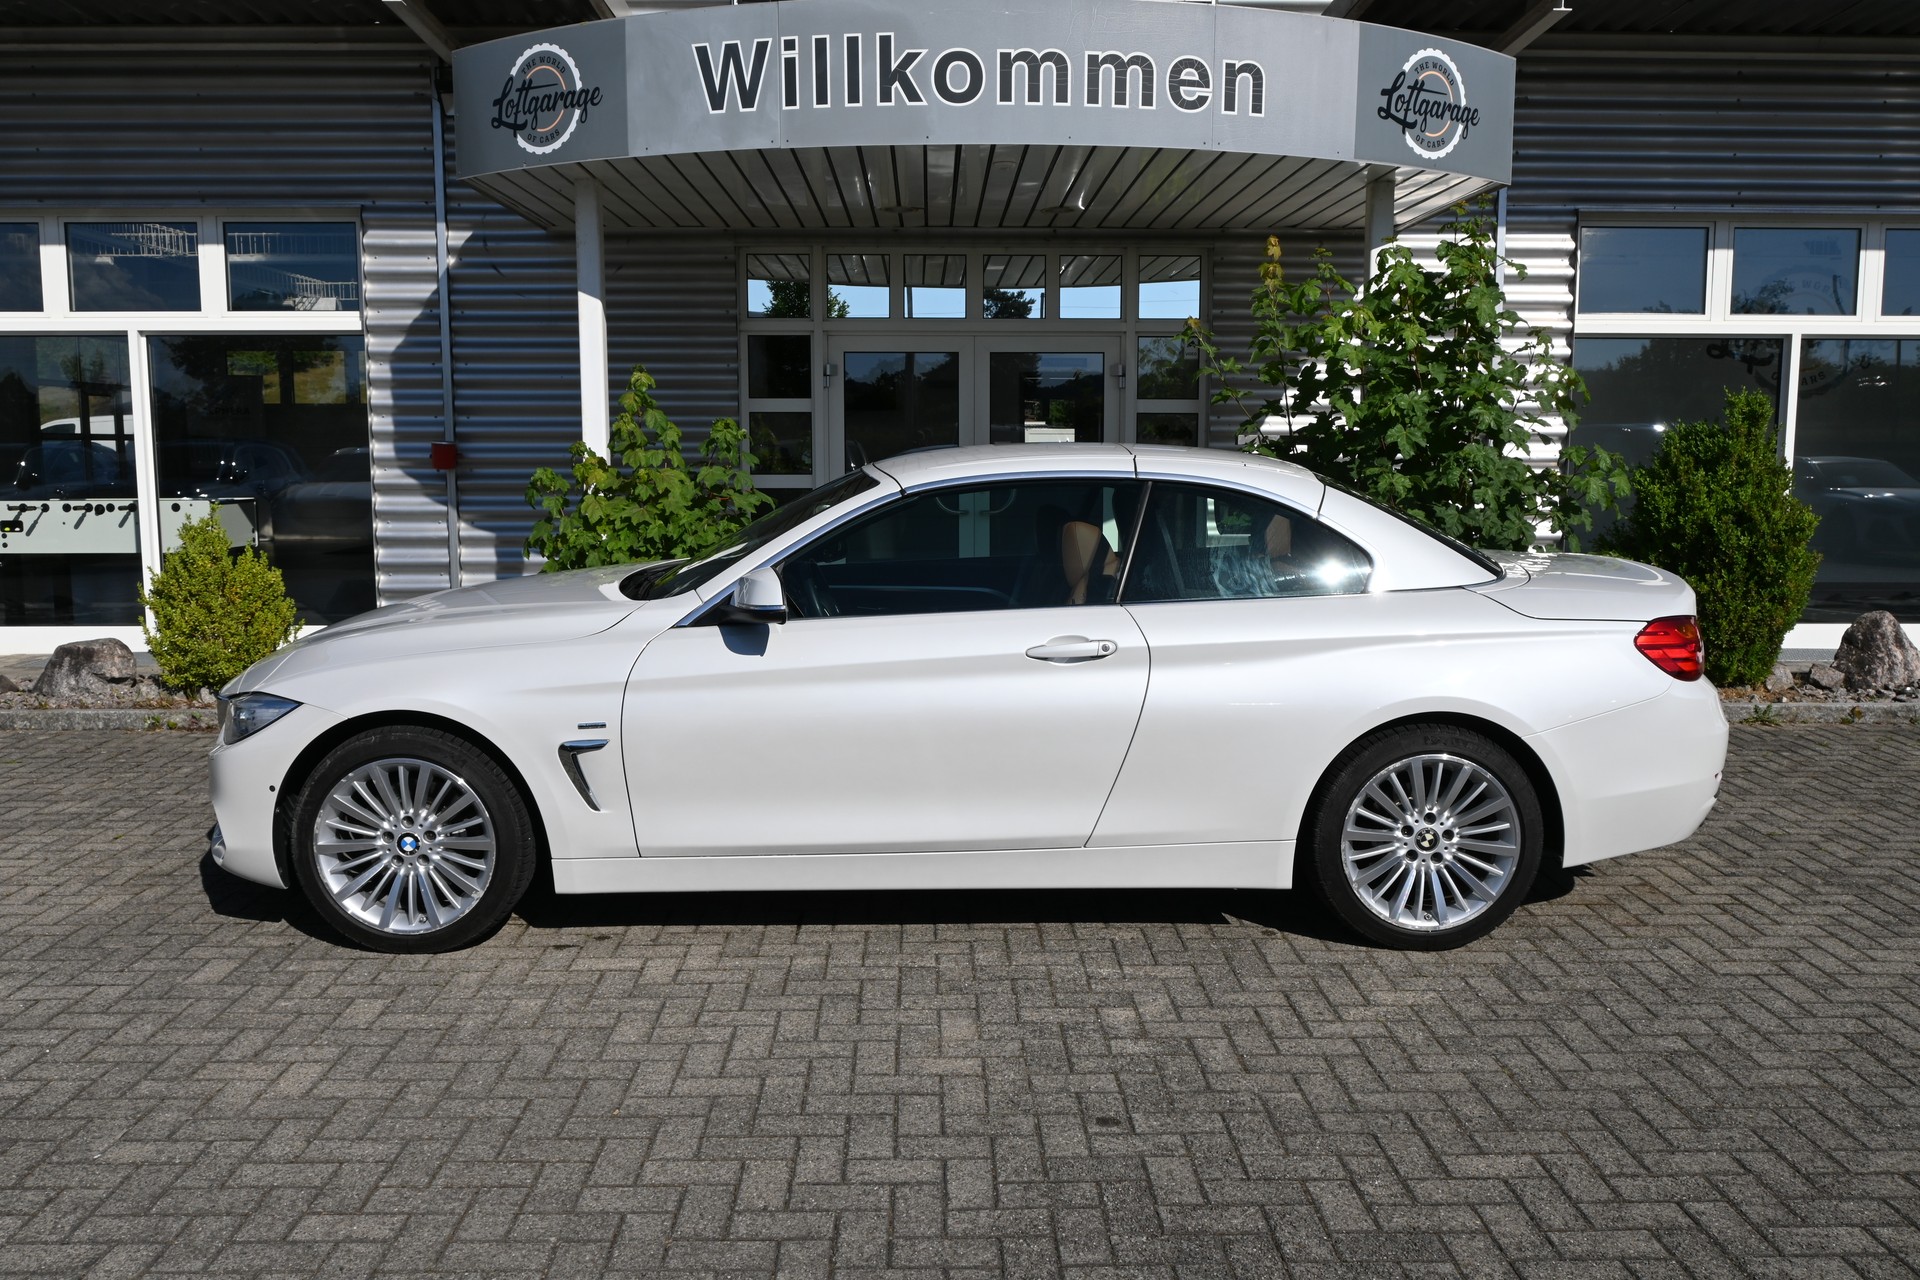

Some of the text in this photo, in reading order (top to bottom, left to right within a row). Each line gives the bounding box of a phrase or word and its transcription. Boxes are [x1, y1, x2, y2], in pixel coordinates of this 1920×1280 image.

[521, 56, 566, 75] THE WORLD
[691, 32, 1266, 118] Willkommen
[1414, 61, 1455, 86] THE WORLD
[491, 75, 604, 138] Loftgarage
[1377, 70, 1481, 140] Loftgarage
[527, 128, 560, 144] OF CARS
[1415, 134, 1446, 149] OF CARS
[1800, 370, 1826, 386] ARS
